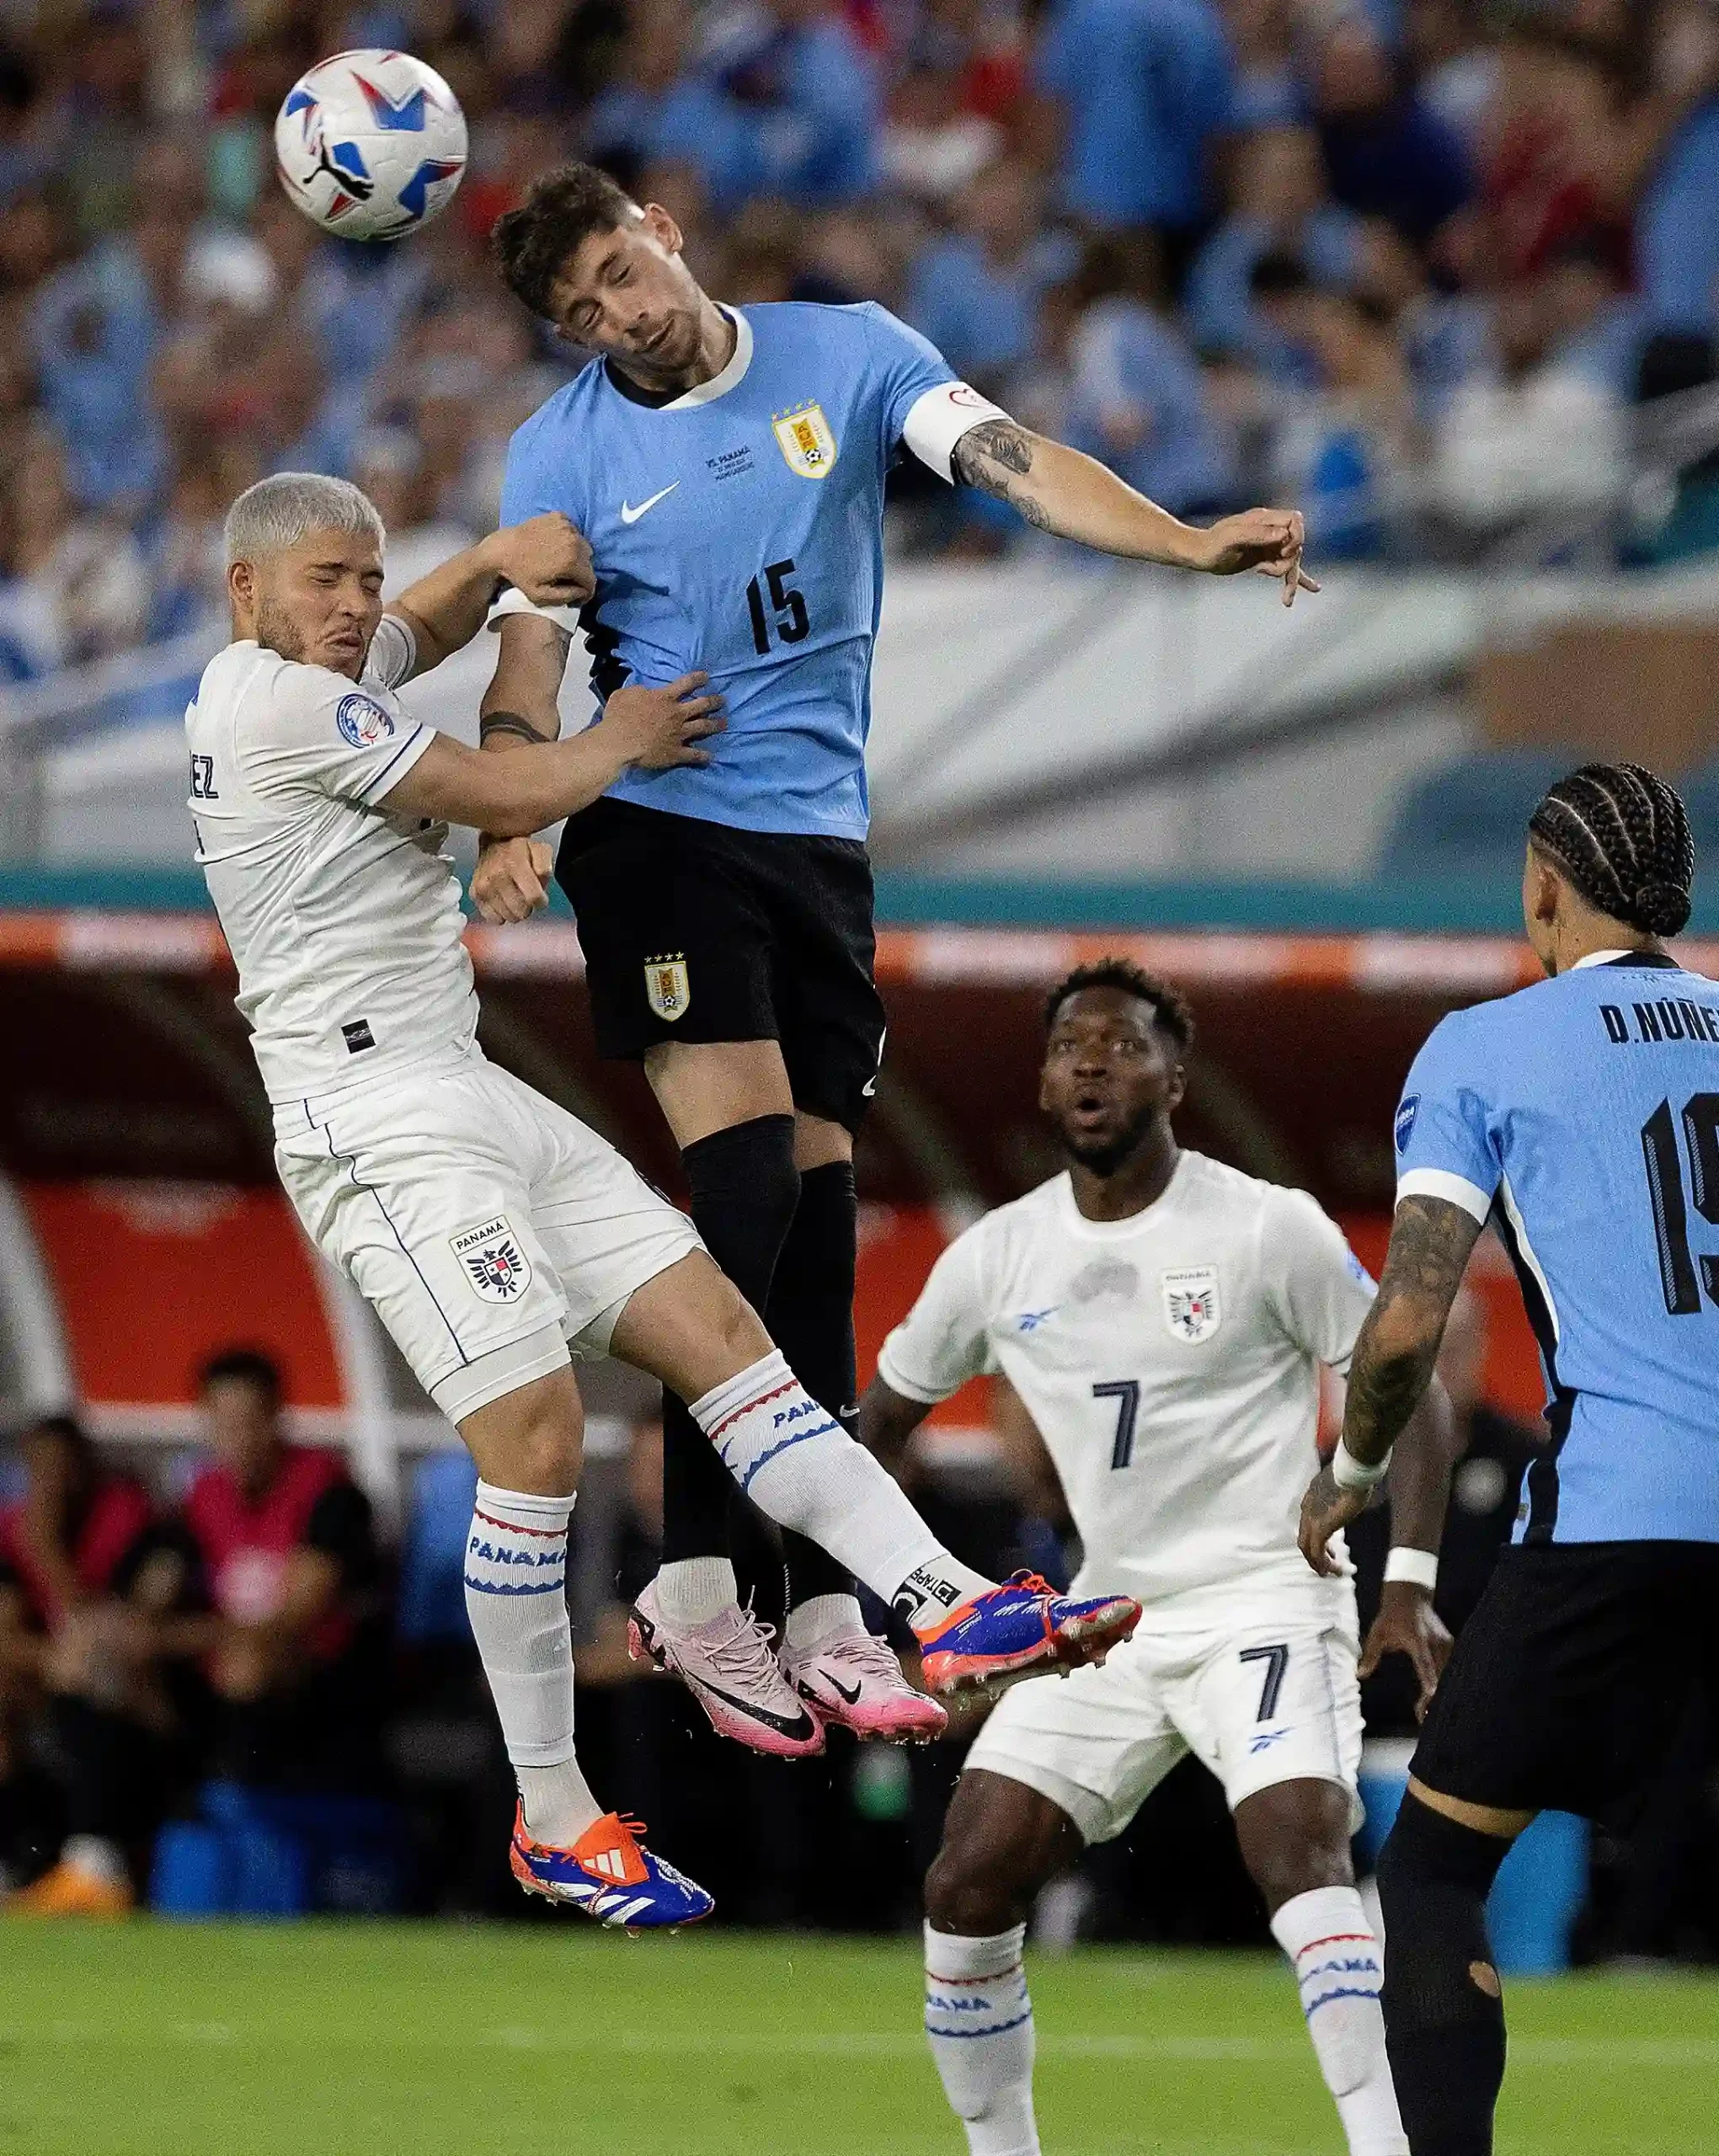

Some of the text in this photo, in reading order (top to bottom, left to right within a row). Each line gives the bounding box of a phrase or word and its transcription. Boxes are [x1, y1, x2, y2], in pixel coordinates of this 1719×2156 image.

[746, 557, 810, 655] 15
[190, 750, 219, 798] EZ
[1599, 997, 1719, 1043] D.NÚÑE
[456, 1220, 504, 1250] PANAMÁ
[1092, 1380, 1140, 1470] 7
[1239, 1644, 1289, 1722] 7
